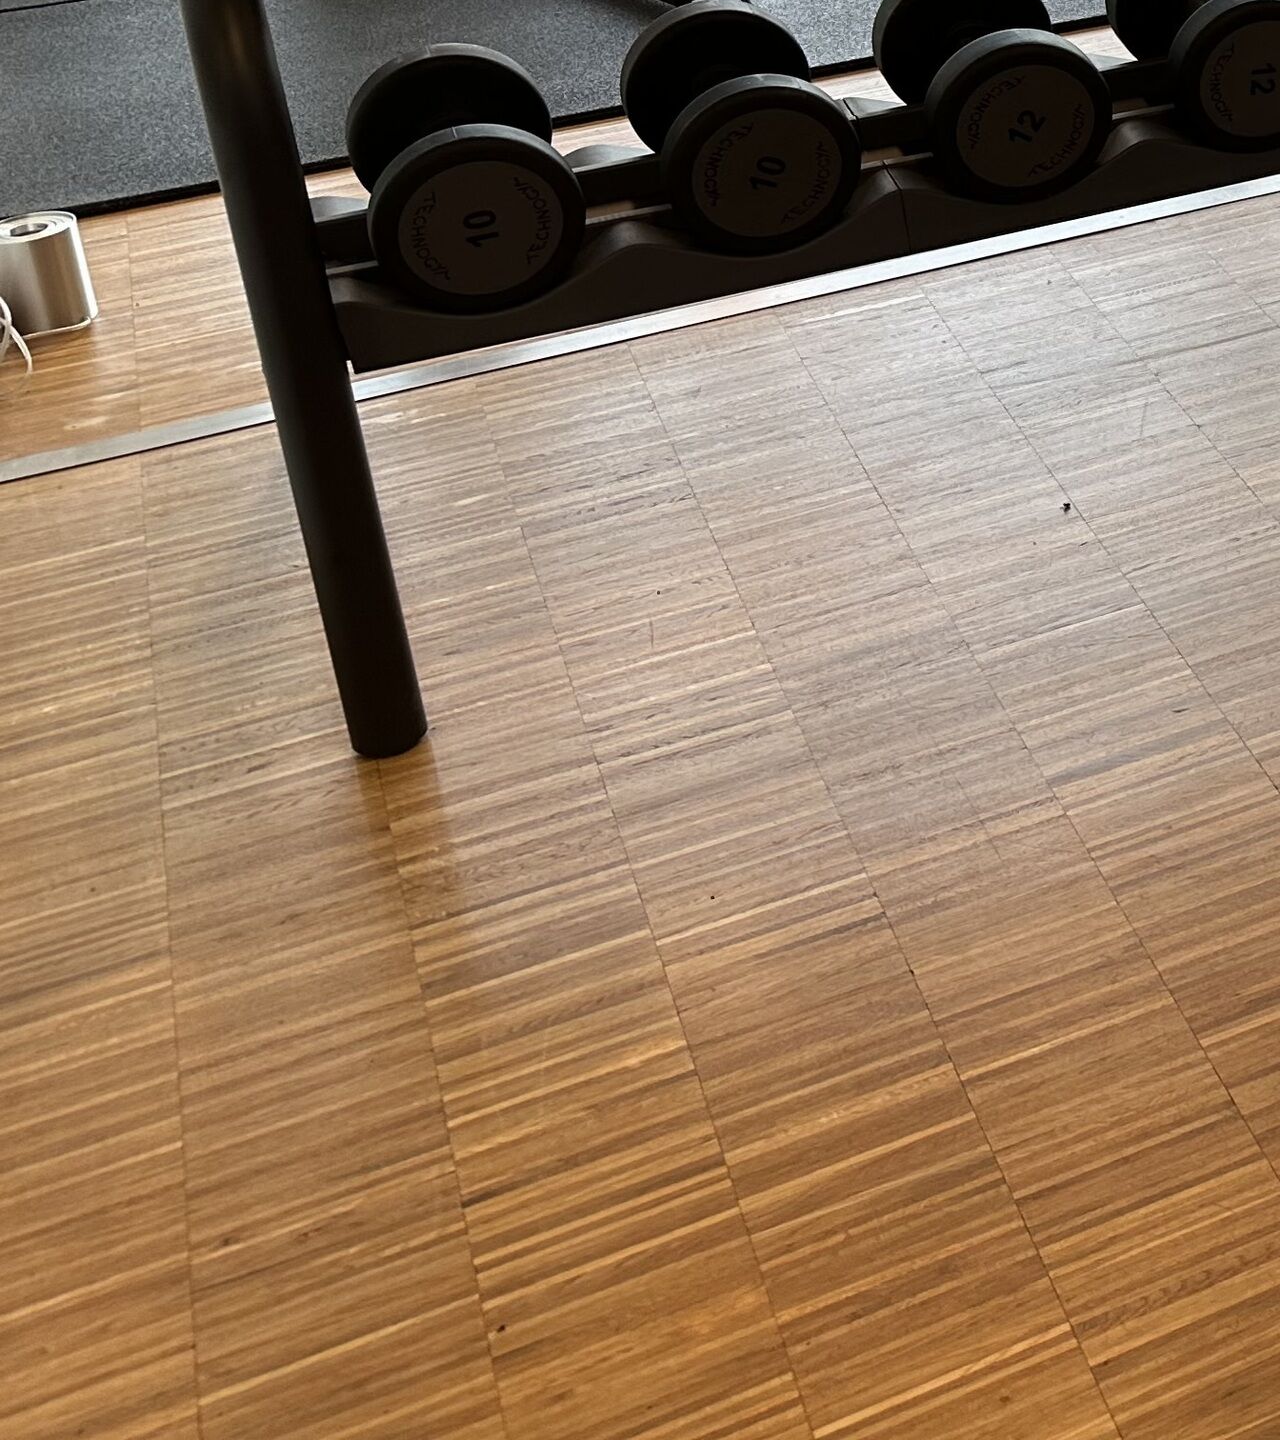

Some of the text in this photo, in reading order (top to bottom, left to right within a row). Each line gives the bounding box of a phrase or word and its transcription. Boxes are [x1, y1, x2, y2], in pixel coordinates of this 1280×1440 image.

[1250, 63, 1277, 96] 12
[1009, 109, 1047, 144] 12
[749, 156, 786, 190] 10
[462, 210, 499, 248] 10
